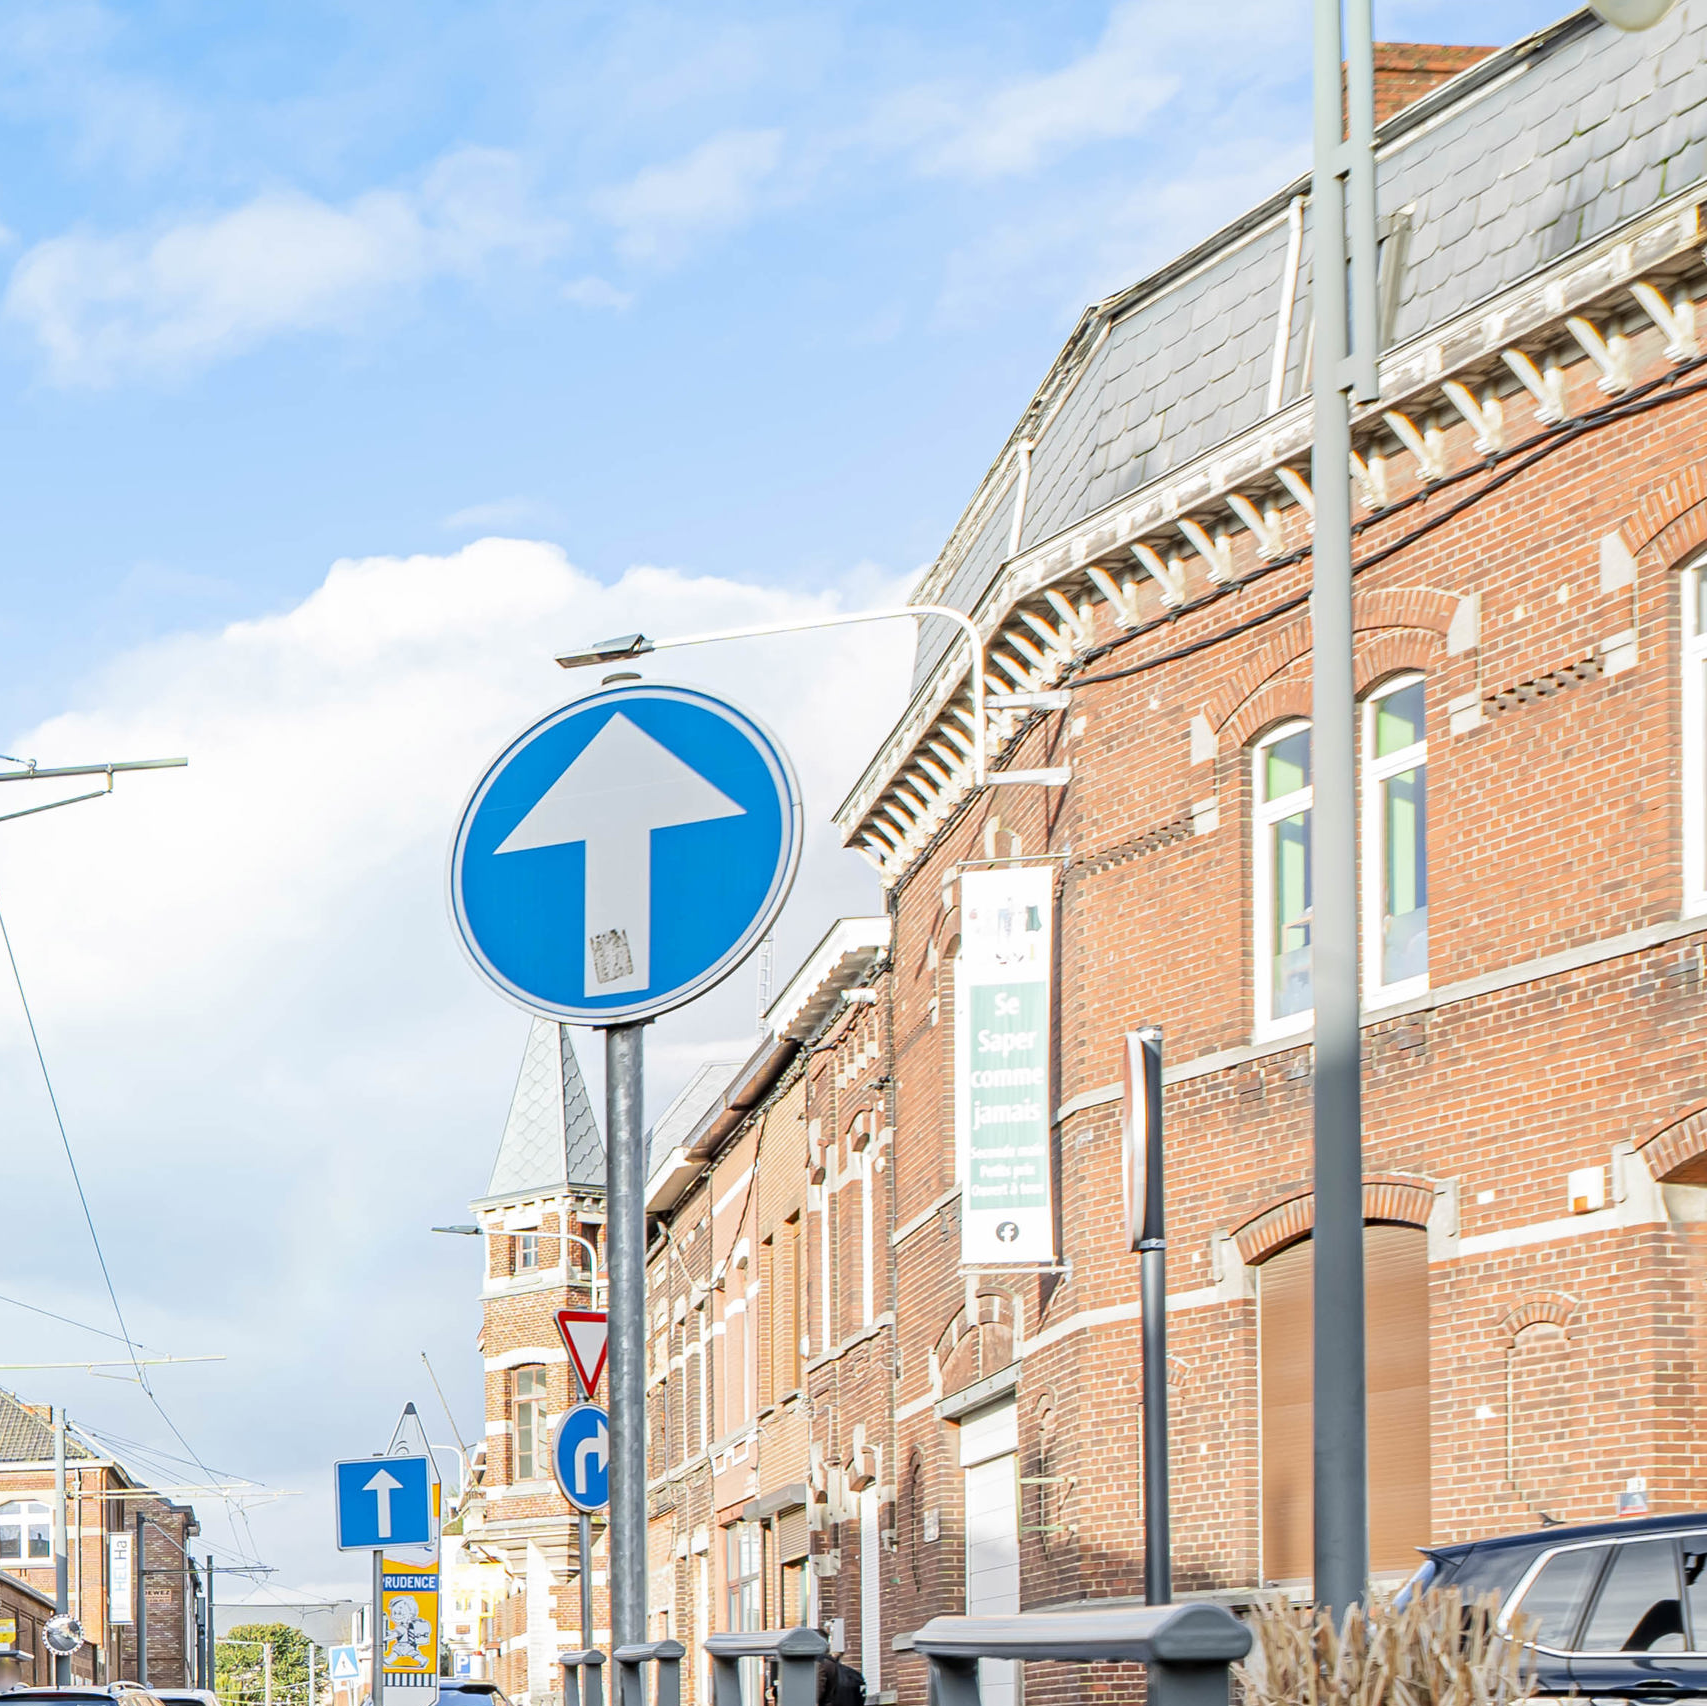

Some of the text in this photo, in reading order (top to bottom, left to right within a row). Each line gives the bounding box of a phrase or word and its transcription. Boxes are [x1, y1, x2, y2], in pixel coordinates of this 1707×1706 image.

[995, 992, 1020, 1016] Se
[978, 1029, 1038, 1058] Saper
[971, 1067, 1044, 1088] comme
[973, 1098, 1041, 1130] jamais
[383, 1576, 436, 1589] RUDENCE
[457, 1655, 469, 1674] P
